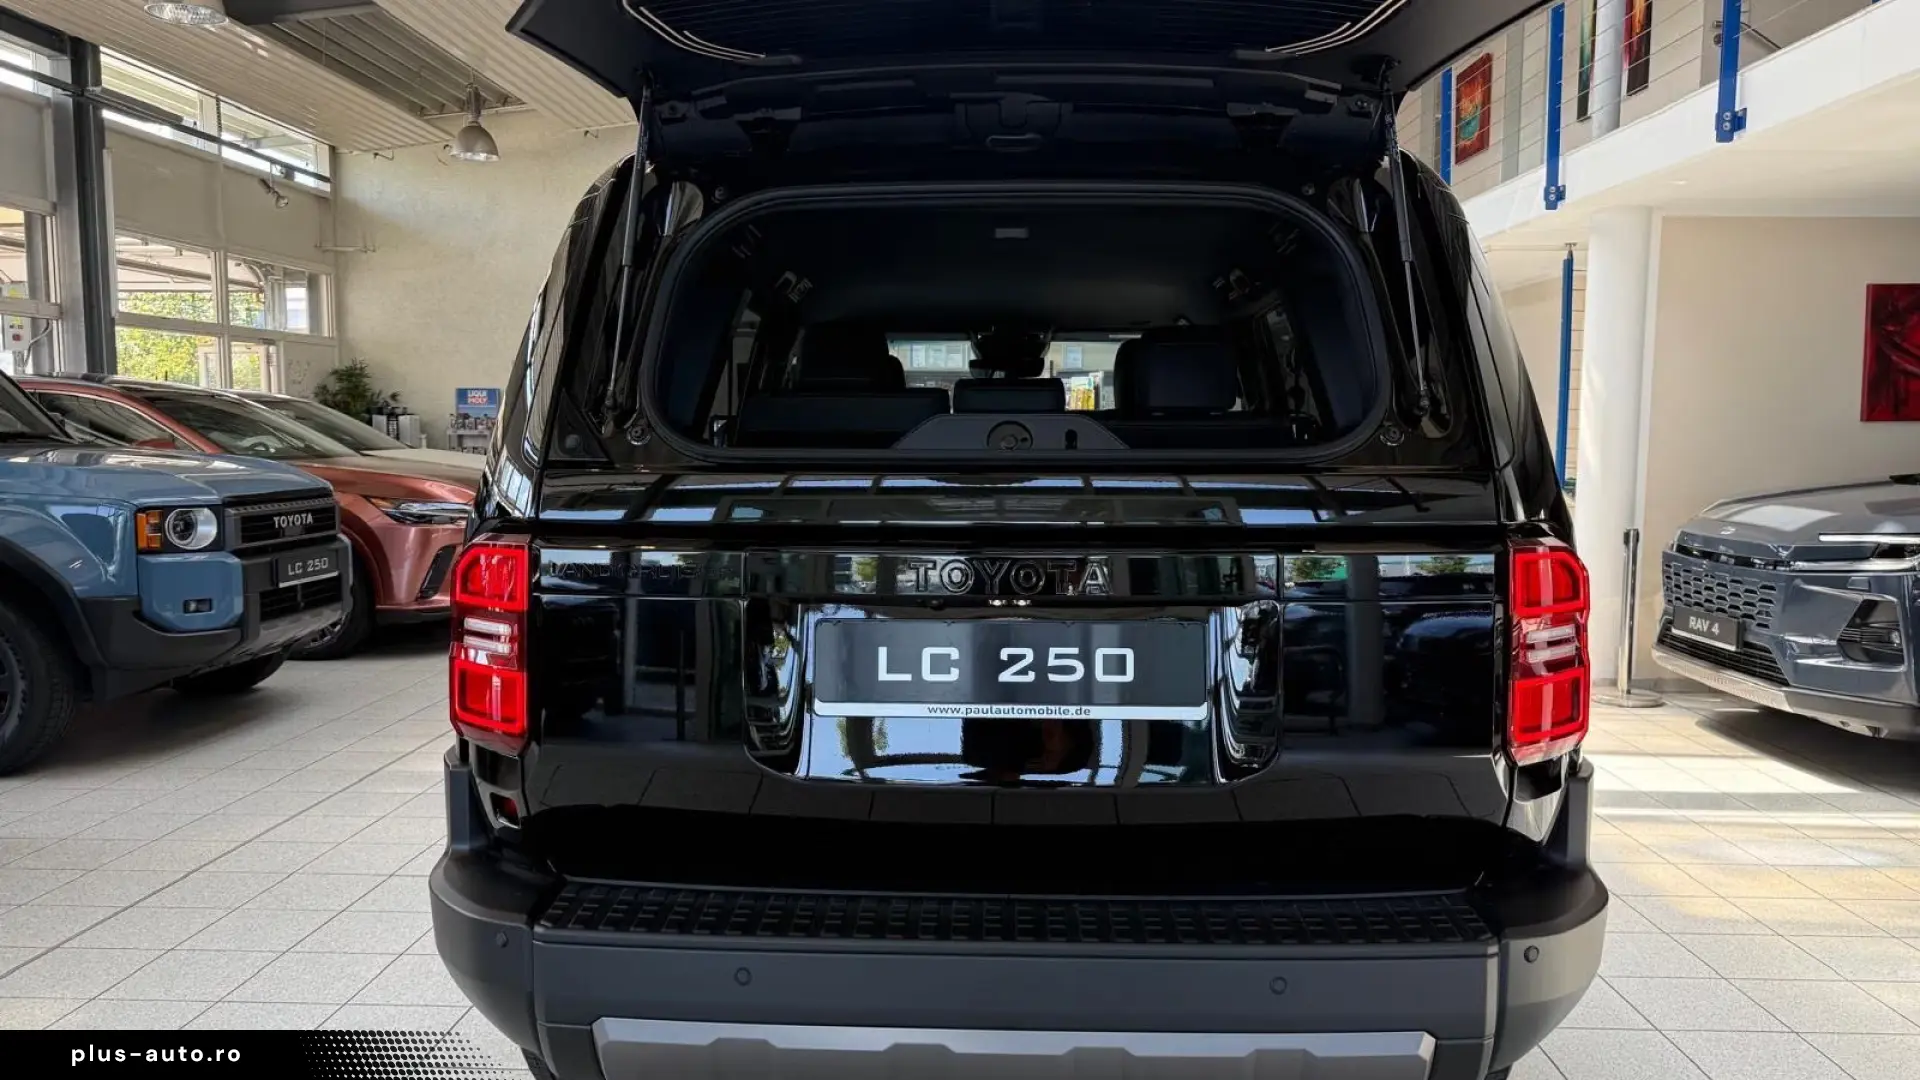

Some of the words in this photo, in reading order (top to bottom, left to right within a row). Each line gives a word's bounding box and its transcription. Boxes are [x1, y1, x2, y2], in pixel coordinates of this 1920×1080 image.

[273, 513, 313, 528] TOYOTA
[288, 562, 303, 575] LC
[307, 557, 329, 572] 250
[910, 556, 1114, 596] TOYOTA
[1689, 616, 1710, 632] RAV
[1711, 622, 1720, 636] 4
[877, 646, 960, 682] LC
[997, 647, 1135, 683] 250
[927, 705, 1091, 717] www.paulautomobile.de
